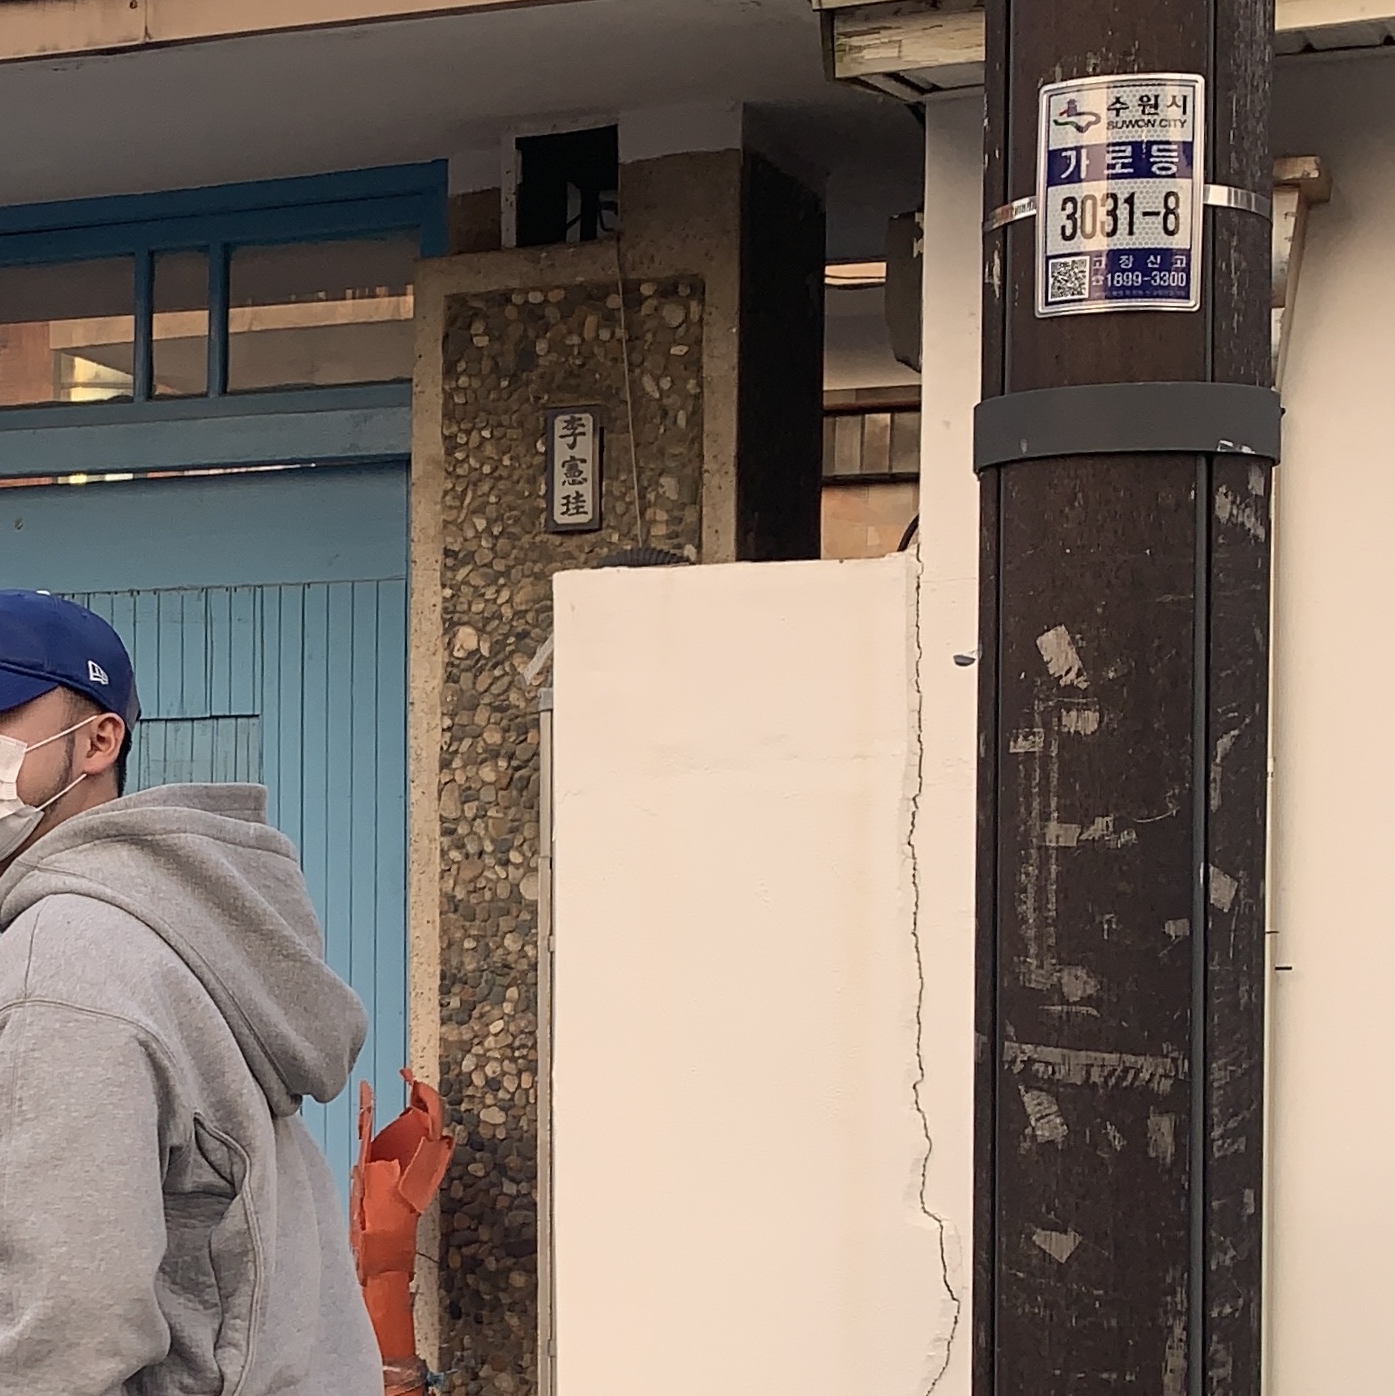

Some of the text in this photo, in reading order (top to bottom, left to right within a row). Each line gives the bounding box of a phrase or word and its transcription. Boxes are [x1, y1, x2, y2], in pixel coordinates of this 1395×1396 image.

[1107, 94, 1187, 117] 수원시
[1107, 119, 1187, 130] SUWON CITY
[1061, 144, 1179, 179] 가로등
[1061, 191, 1180, 242] 3031-8
[1106, 271, 1186, 287] 1899-3300
